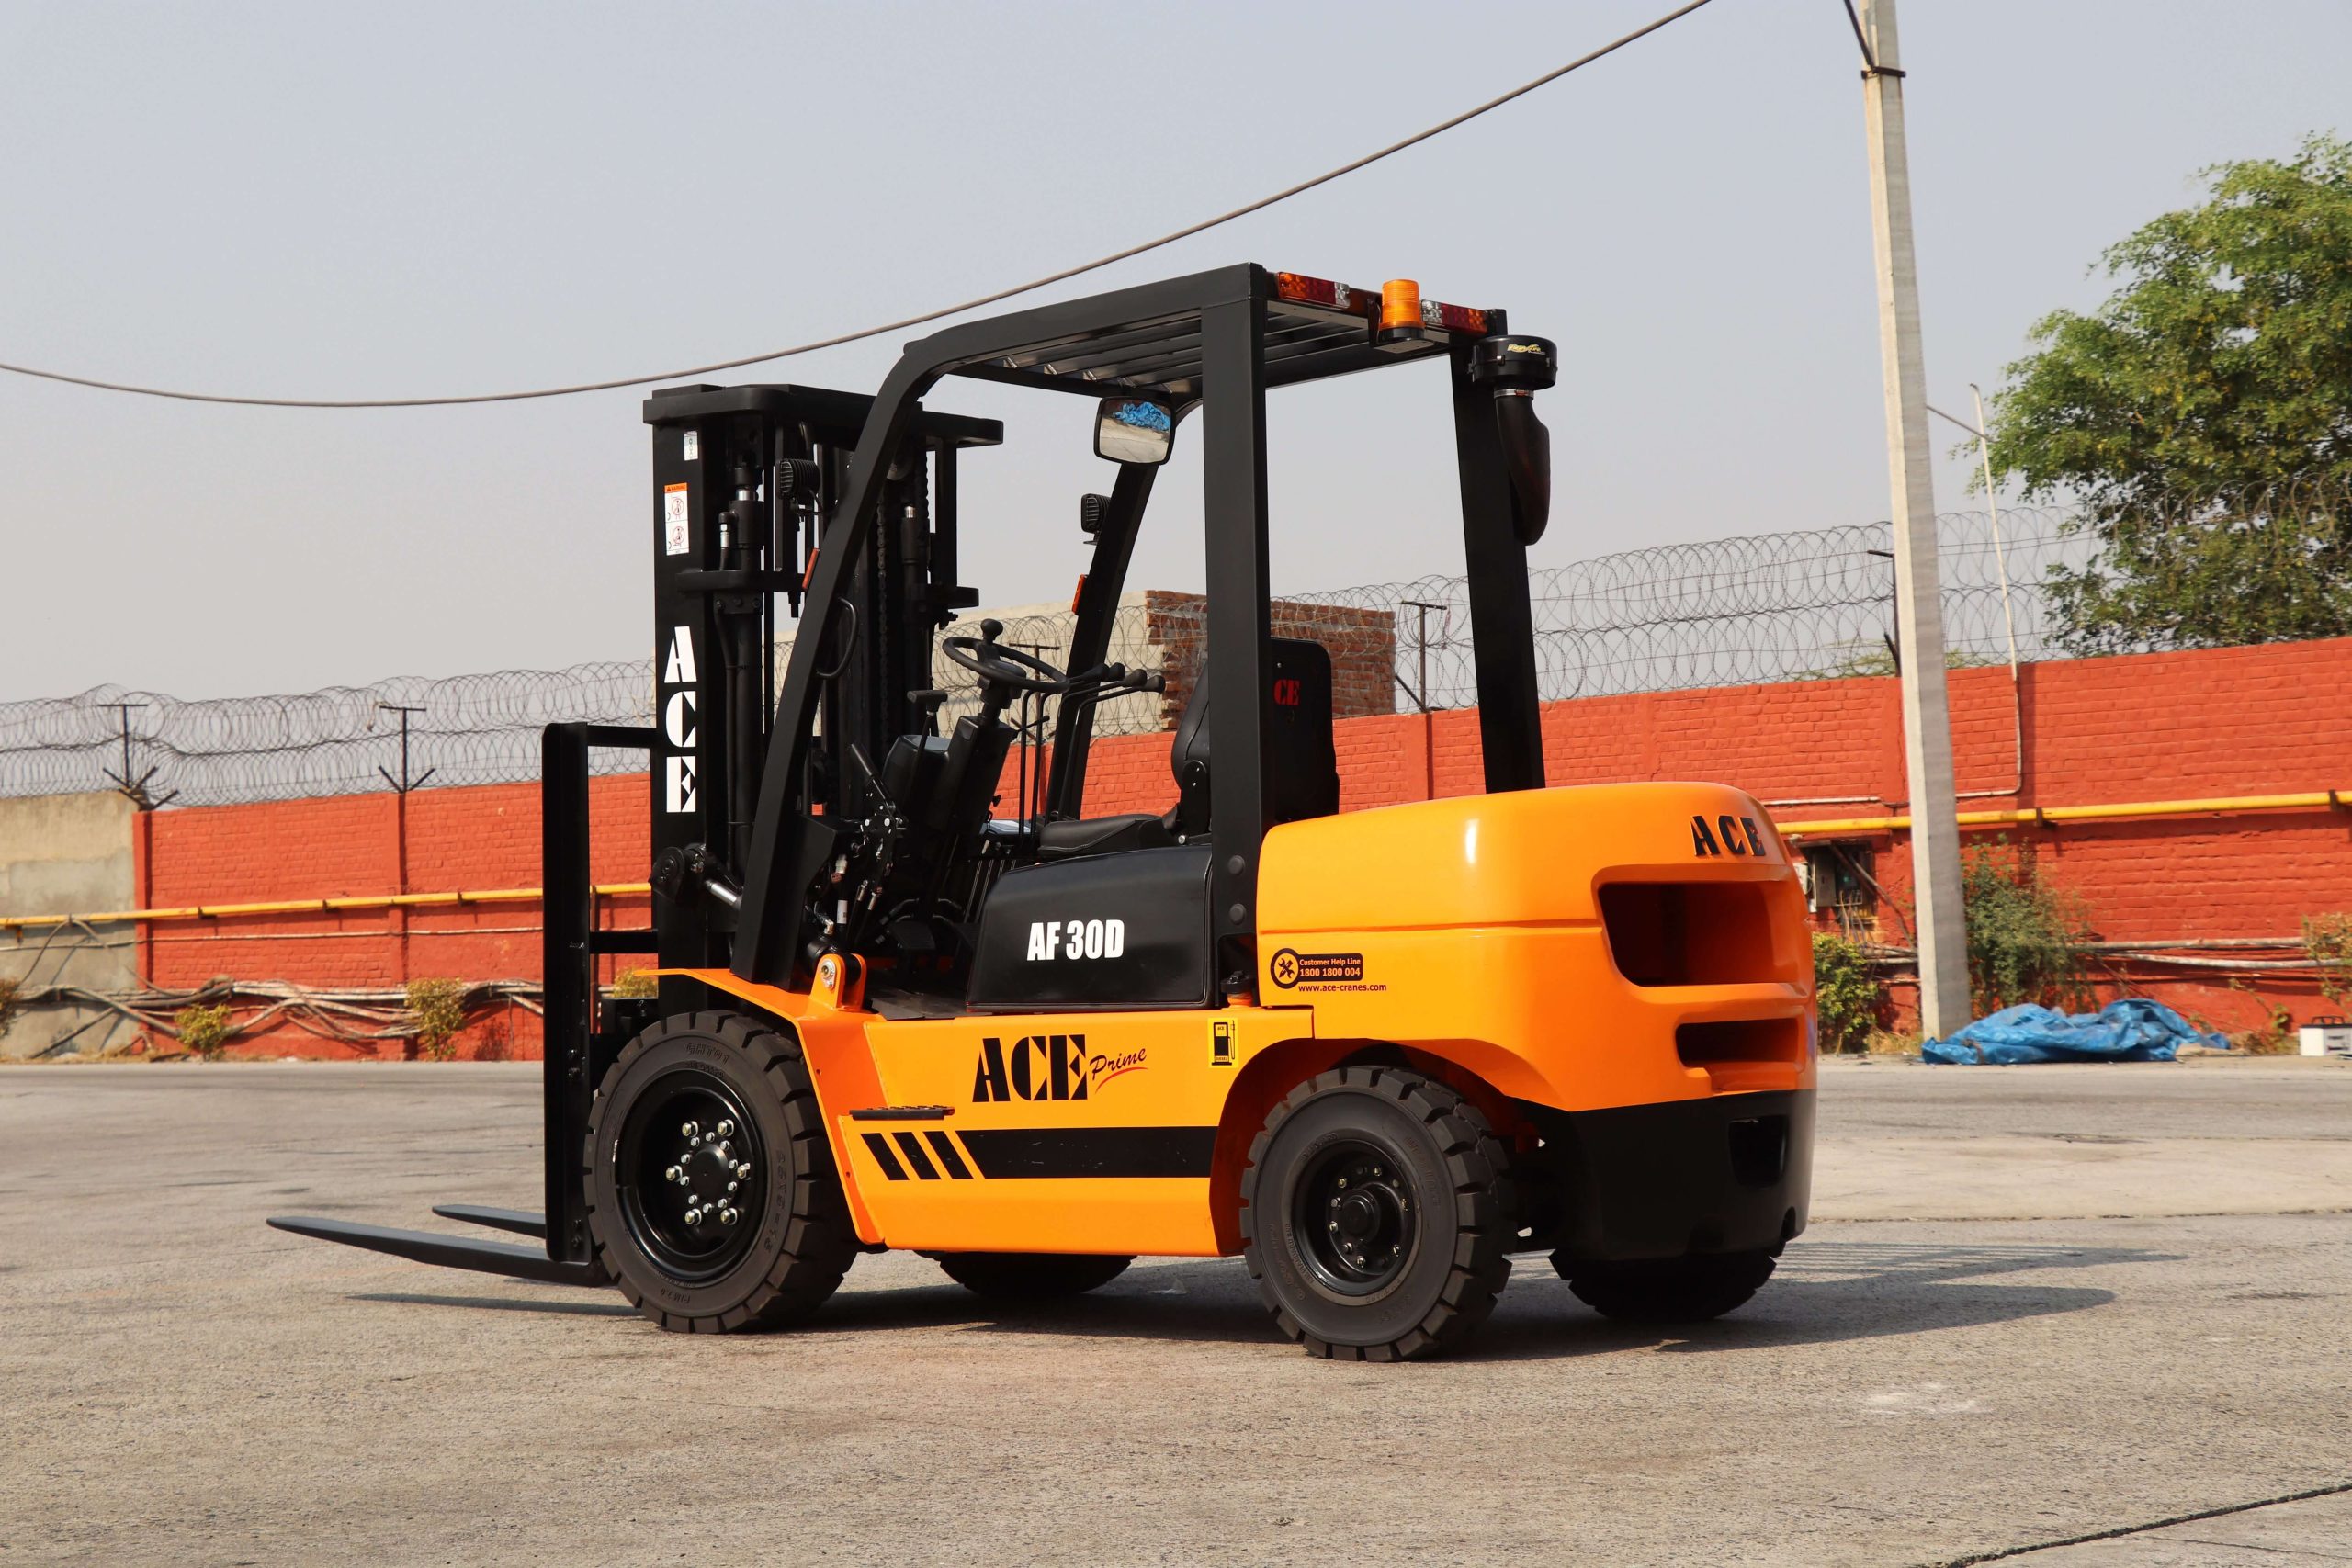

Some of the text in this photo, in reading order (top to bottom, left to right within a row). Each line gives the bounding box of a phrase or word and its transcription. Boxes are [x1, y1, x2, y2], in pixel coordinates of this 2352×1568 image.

[1272, 679, 1301, 705] CE
[664, 626, 697, 813] ACE
[1690, 815, 1766, 856] ACE
[1026, 919, 1125, 961] AF 30D
[1299, 958, 1329, 966] Customer
[1330, 958, 1346, 966] Help
[1299, 967, 1361, 977] 1800 1800 004
[1298, 984, 1387, 992] www.ace-cranes.com
[972, 1034, 1148, 1102] ACE Prime
